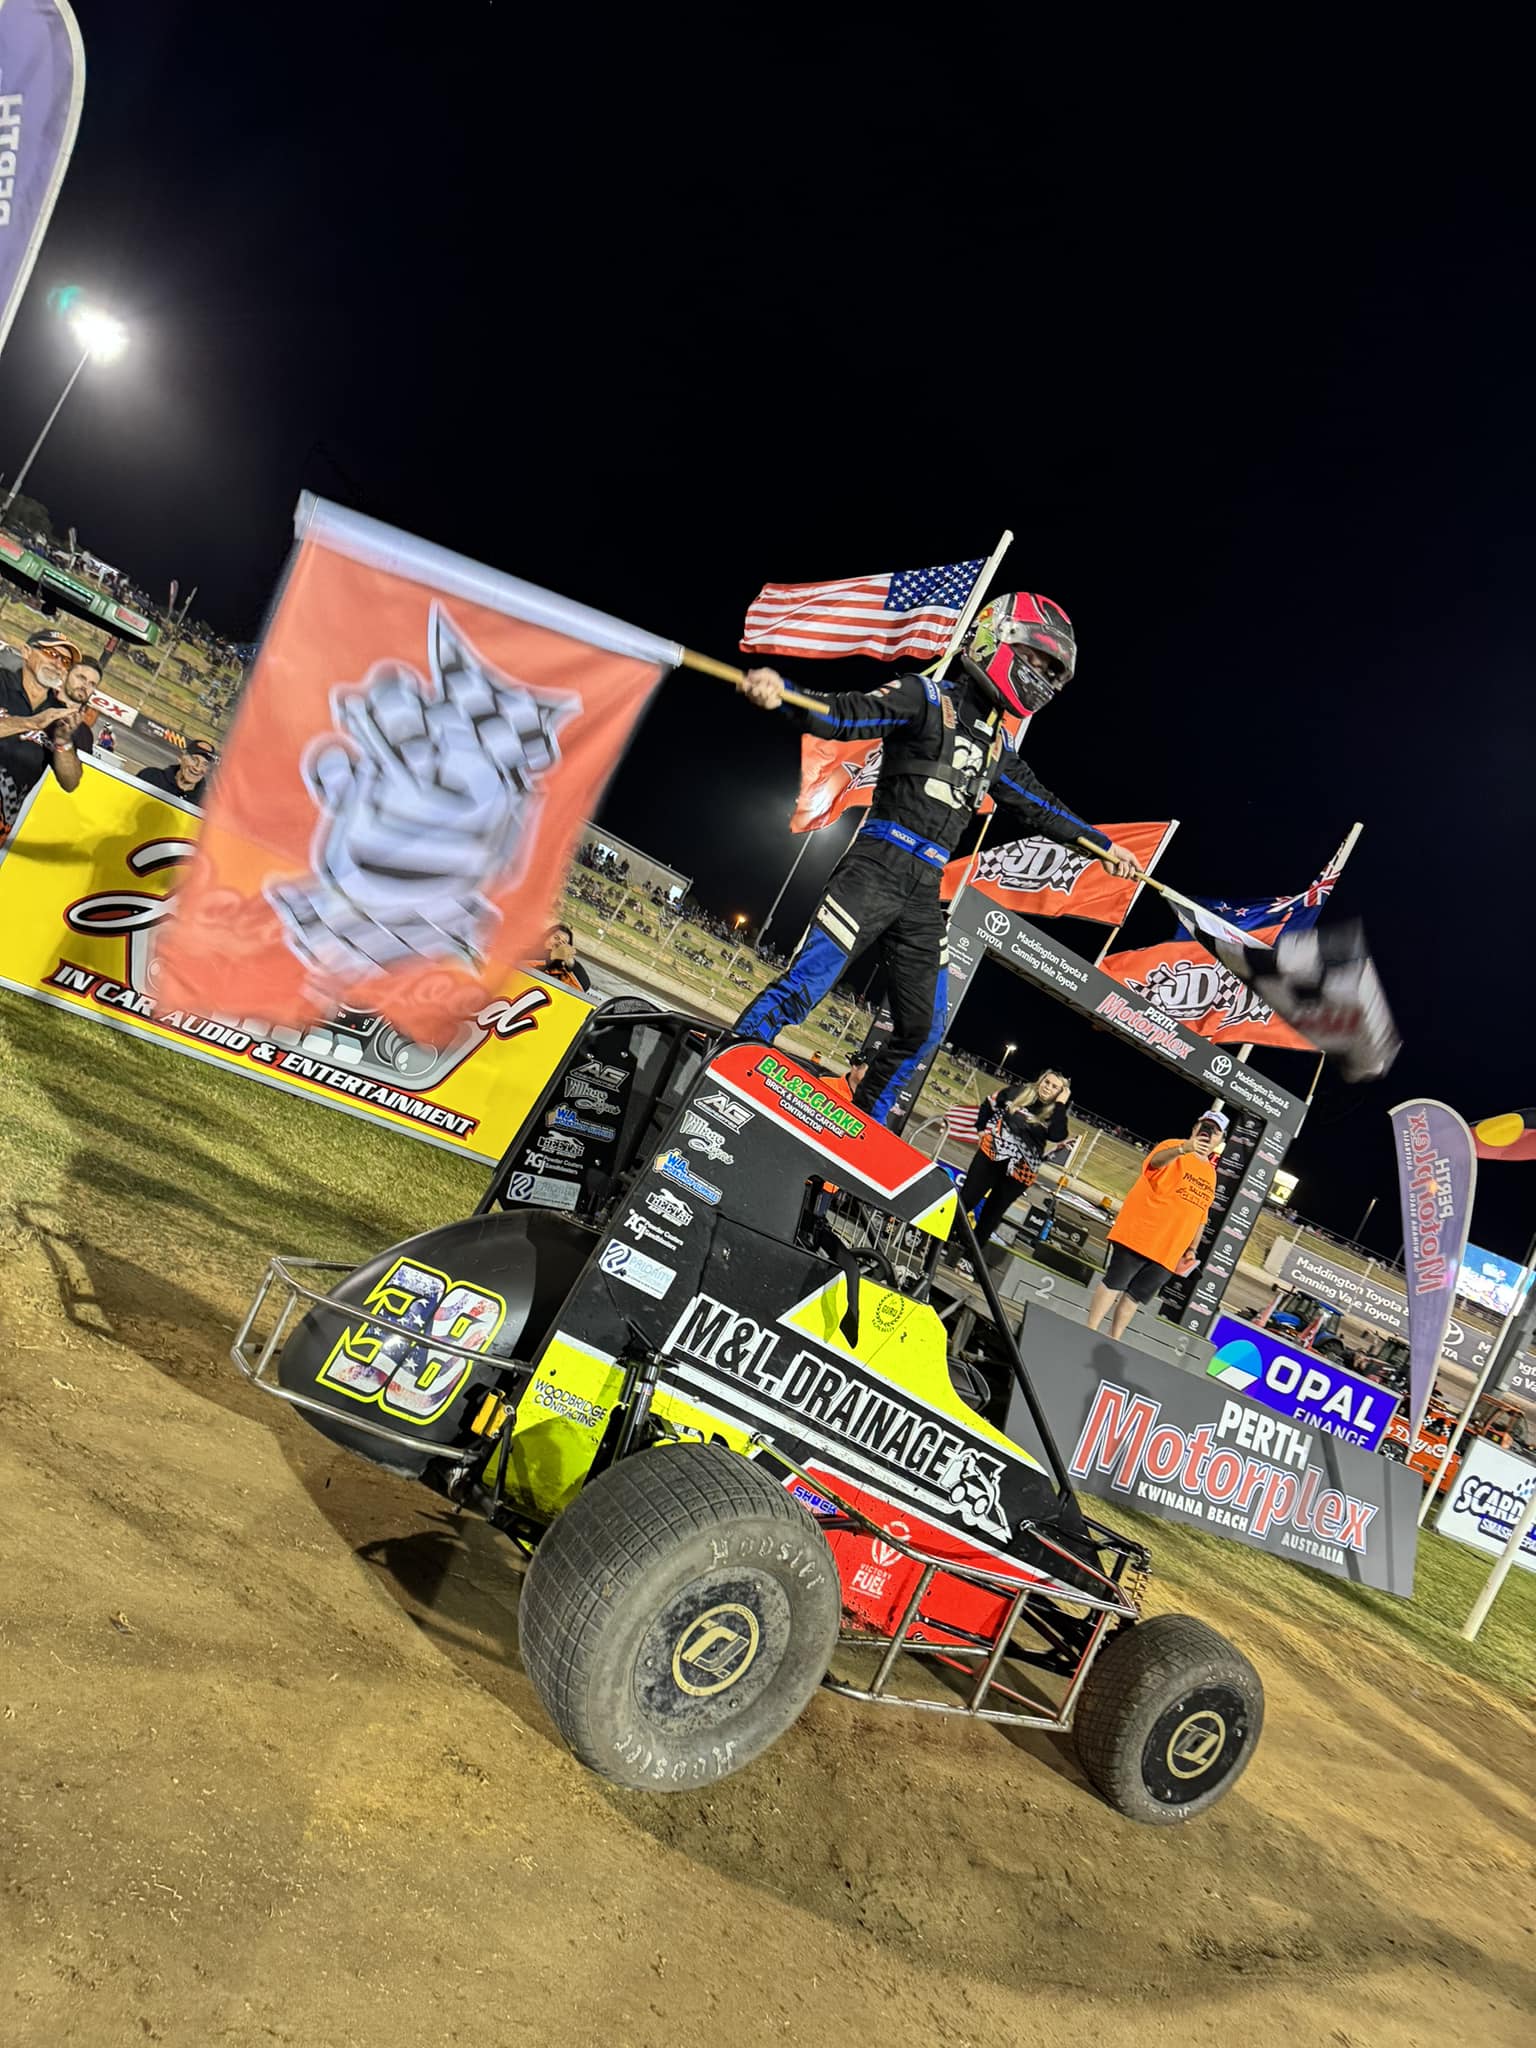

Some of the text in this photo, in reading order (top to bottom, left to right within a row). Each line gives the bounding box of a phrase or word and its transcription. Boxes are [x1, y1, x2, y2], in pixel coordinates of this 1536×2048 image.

[976, 927, 1003, 950] TOYOTA
[1017, 931, 1089, 984] Maddington Toyota &
[1011, 943, 1079, 992] Canning Vale Toyota
[1160, 963, 1220, 1008] JD
[1095, 991, 1196, 1061] Motorplex
[1144, 1006, 1179, 1032] PERTH
[53, 965, 476, 1137] IN CAR AUDIO & ENTERTAINMENT
[1235, 1070, 1268, 1098] Maddington
[679, 1109, 726, 1144] Village
[702, 1094, 753, 1127] AG
[764, 1078, 845, 1138] BRICK & PAVING CARTAGE
[779, 1099, 824, 1133] CONTRACTOR
[1034, 1276, 1056, 1300] 2
[1291, 1268, 1337, 1299] Canning
[1361, 1302, 1401, 1328] Toyota
[1296, 1256, 1363, 1297] Maddington
[1364, 1285, 1403, 1313] Toyota
[534, 1378, 608, 1421] WOODBRIDGE
[534, 1393, 598, 1428] CONTRACTING
[1265, 1355, 1377, 1433] OPAL
[780, 1352, 967, 1486] DRAINAGE
[1216, 1400, 1313, 1470] PERTH
[1067, 1379, 1380, 1555] Motorplex
[793, 1484, 839, 1516] SHOCK
[1136, 1481, 1250, 1533] KWINANA BEACH
[1453, 1475, 1527, 1525] SCARD
[1280, 1531, 1345, 1566] AUSTRALIA
[851, 1569, 884, 1596] FUEL
[859, 1563, 892, 1580] VICTORY
